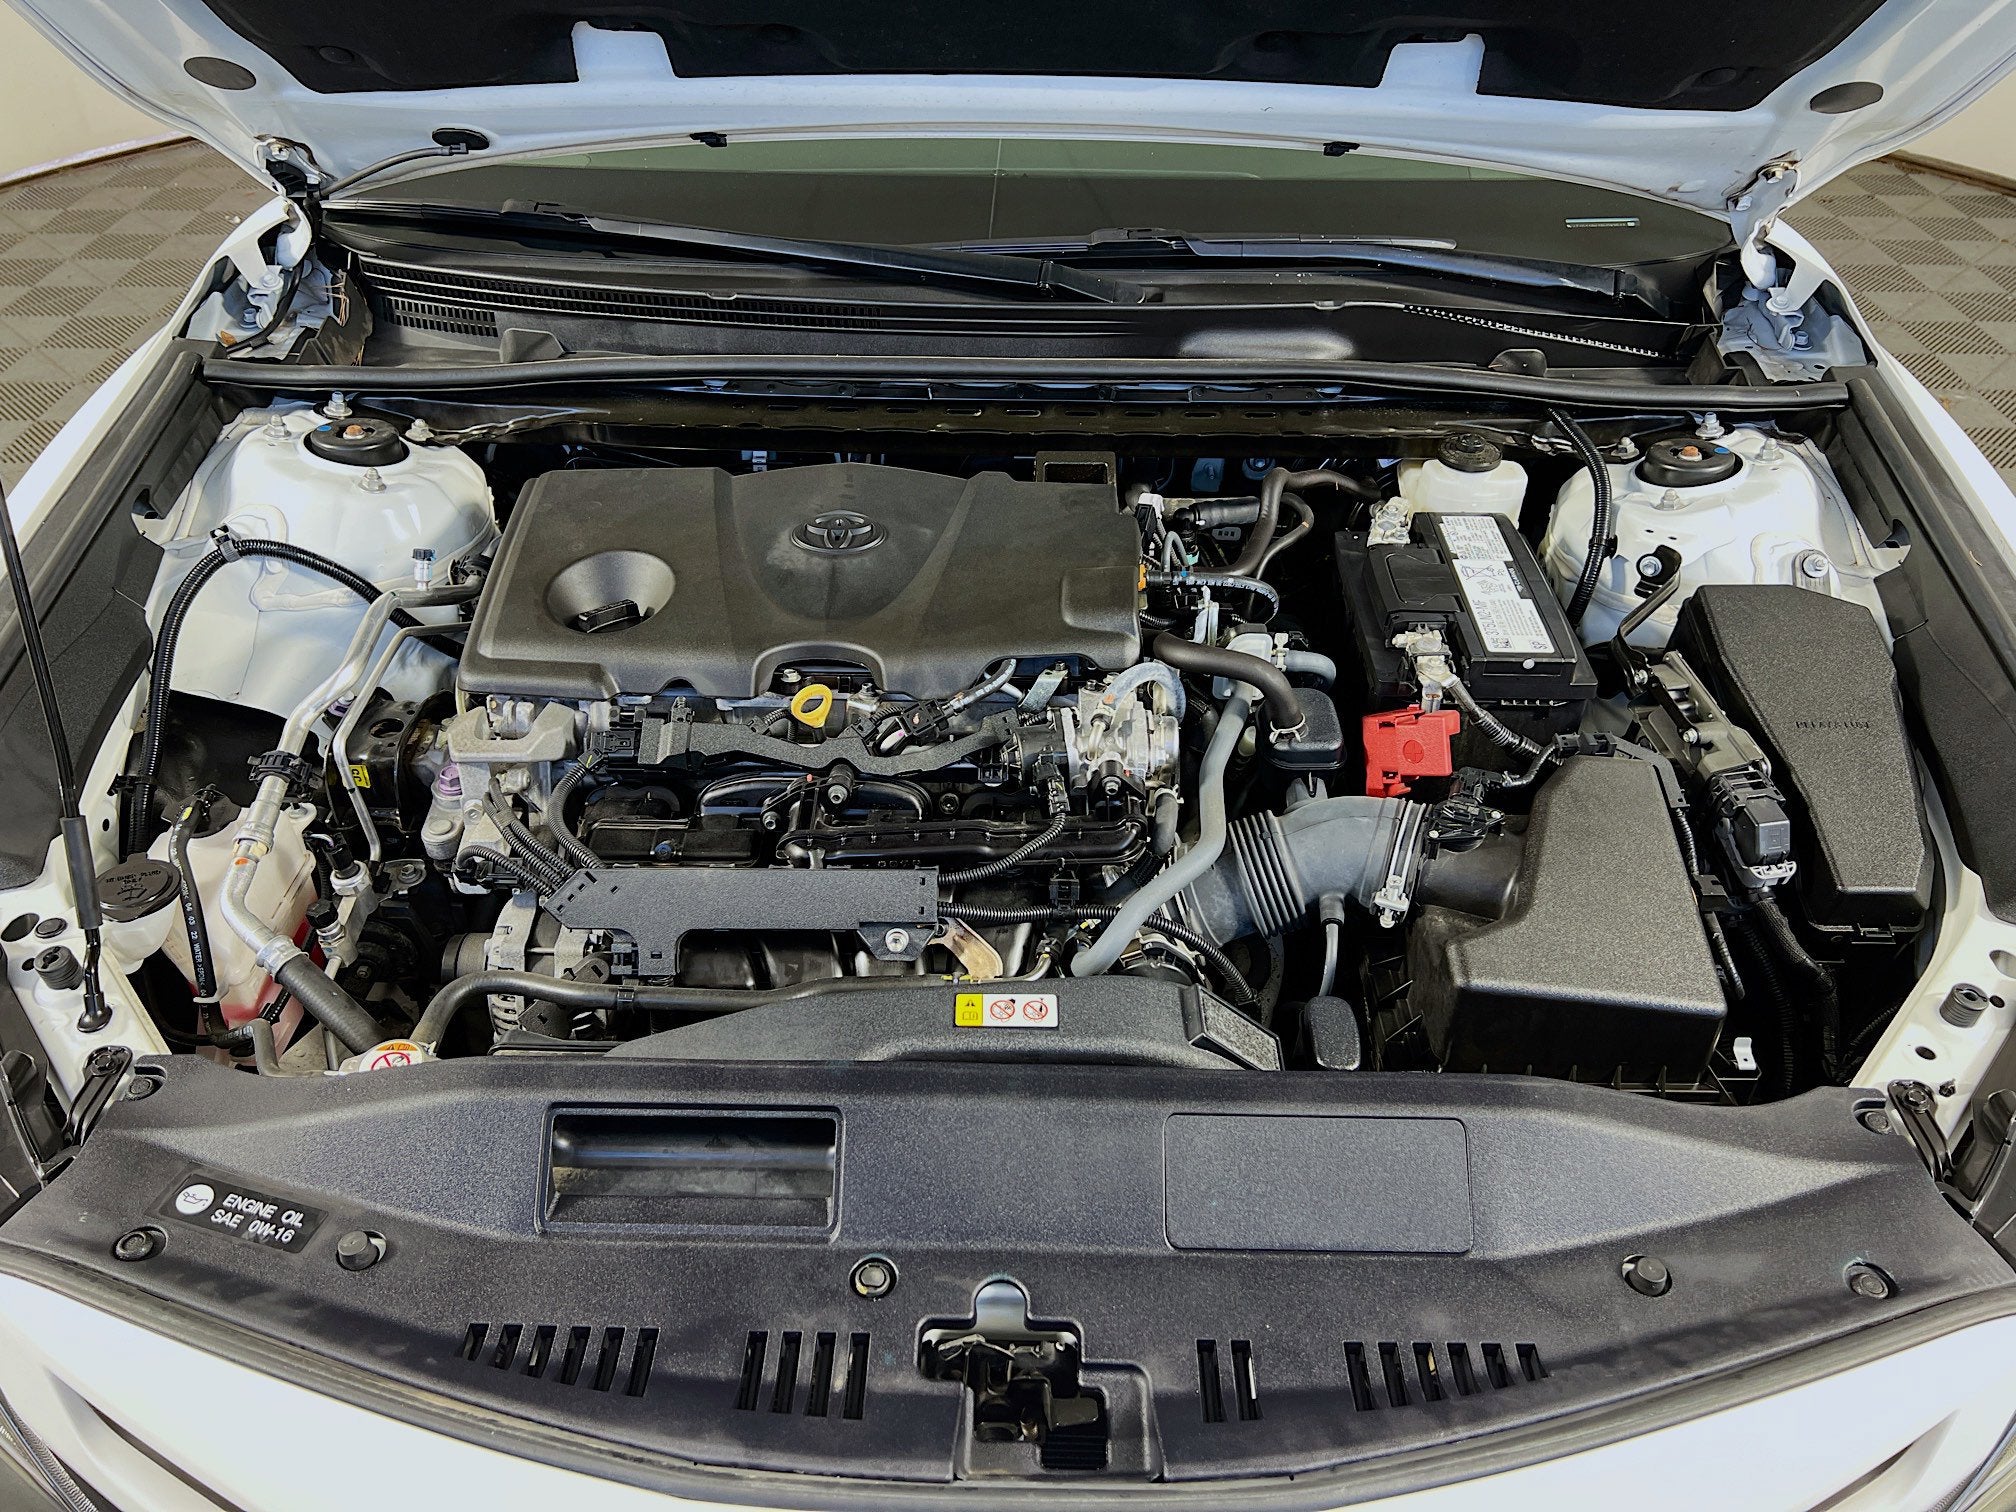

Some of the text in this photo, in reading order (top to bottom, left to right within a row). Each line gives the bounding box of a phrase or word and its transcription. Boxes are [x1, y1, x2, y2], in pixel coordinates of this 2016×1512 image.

[190, 930, 198, 940] 22
[210, 1209, 296, 1244] SAE 0W-16
[222, 1193, 304, 1228] ENGINE OIL
